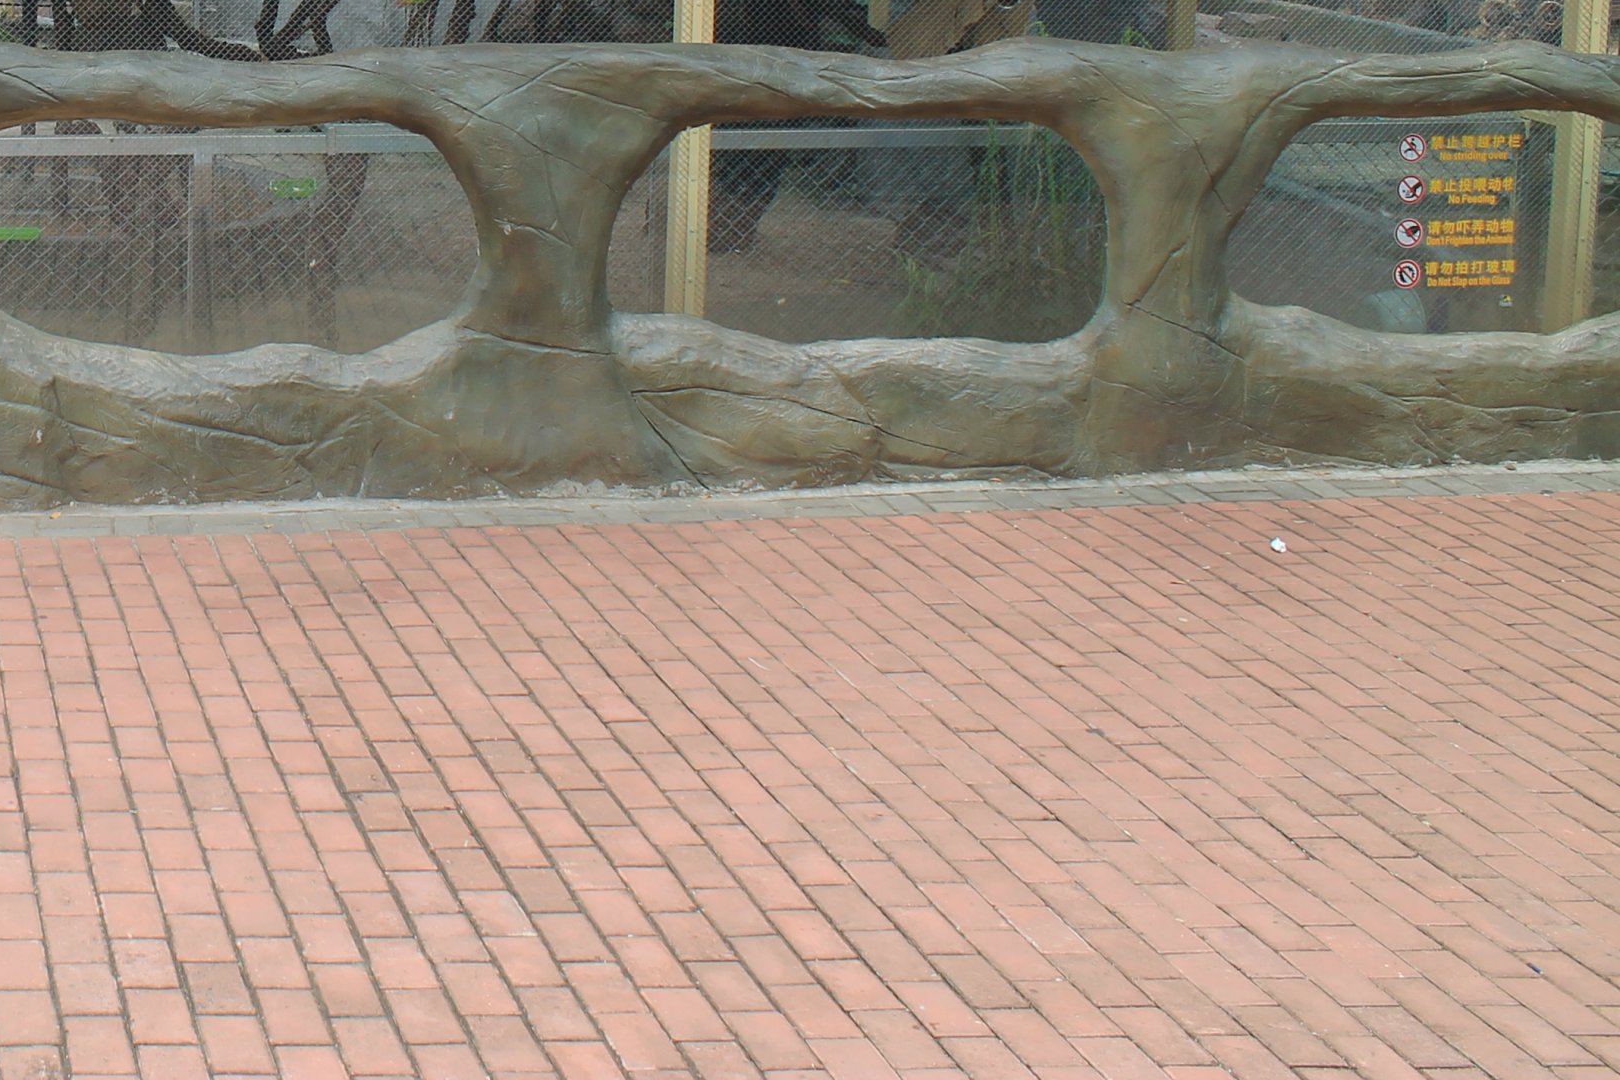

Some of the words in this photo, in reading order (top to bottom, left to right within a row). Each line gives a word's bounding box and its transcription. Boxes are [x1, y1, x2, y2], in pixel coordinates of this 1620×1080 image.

[1431, 134, 1522, 149] 禁止跨越护栏
[1440, 152, 1453, 161] No
[1453, 151, 1487, 162] striding
[1488, 151, 1508, 161] over
[1448, 194, 1461, 204] No
[1462, 194, 1497, 206] Feeding
[1427, 219, 1515, 234] 请勿吓弄动物
[1425, 261, 1515, 276] 请勿拍打玻璃
[1426, 277, 1438, 287] Do
[1438, 277, 1452, 287] Not
[1451, 276, 1468, 288] Slap
[1468, 278, 1478, 286] on
